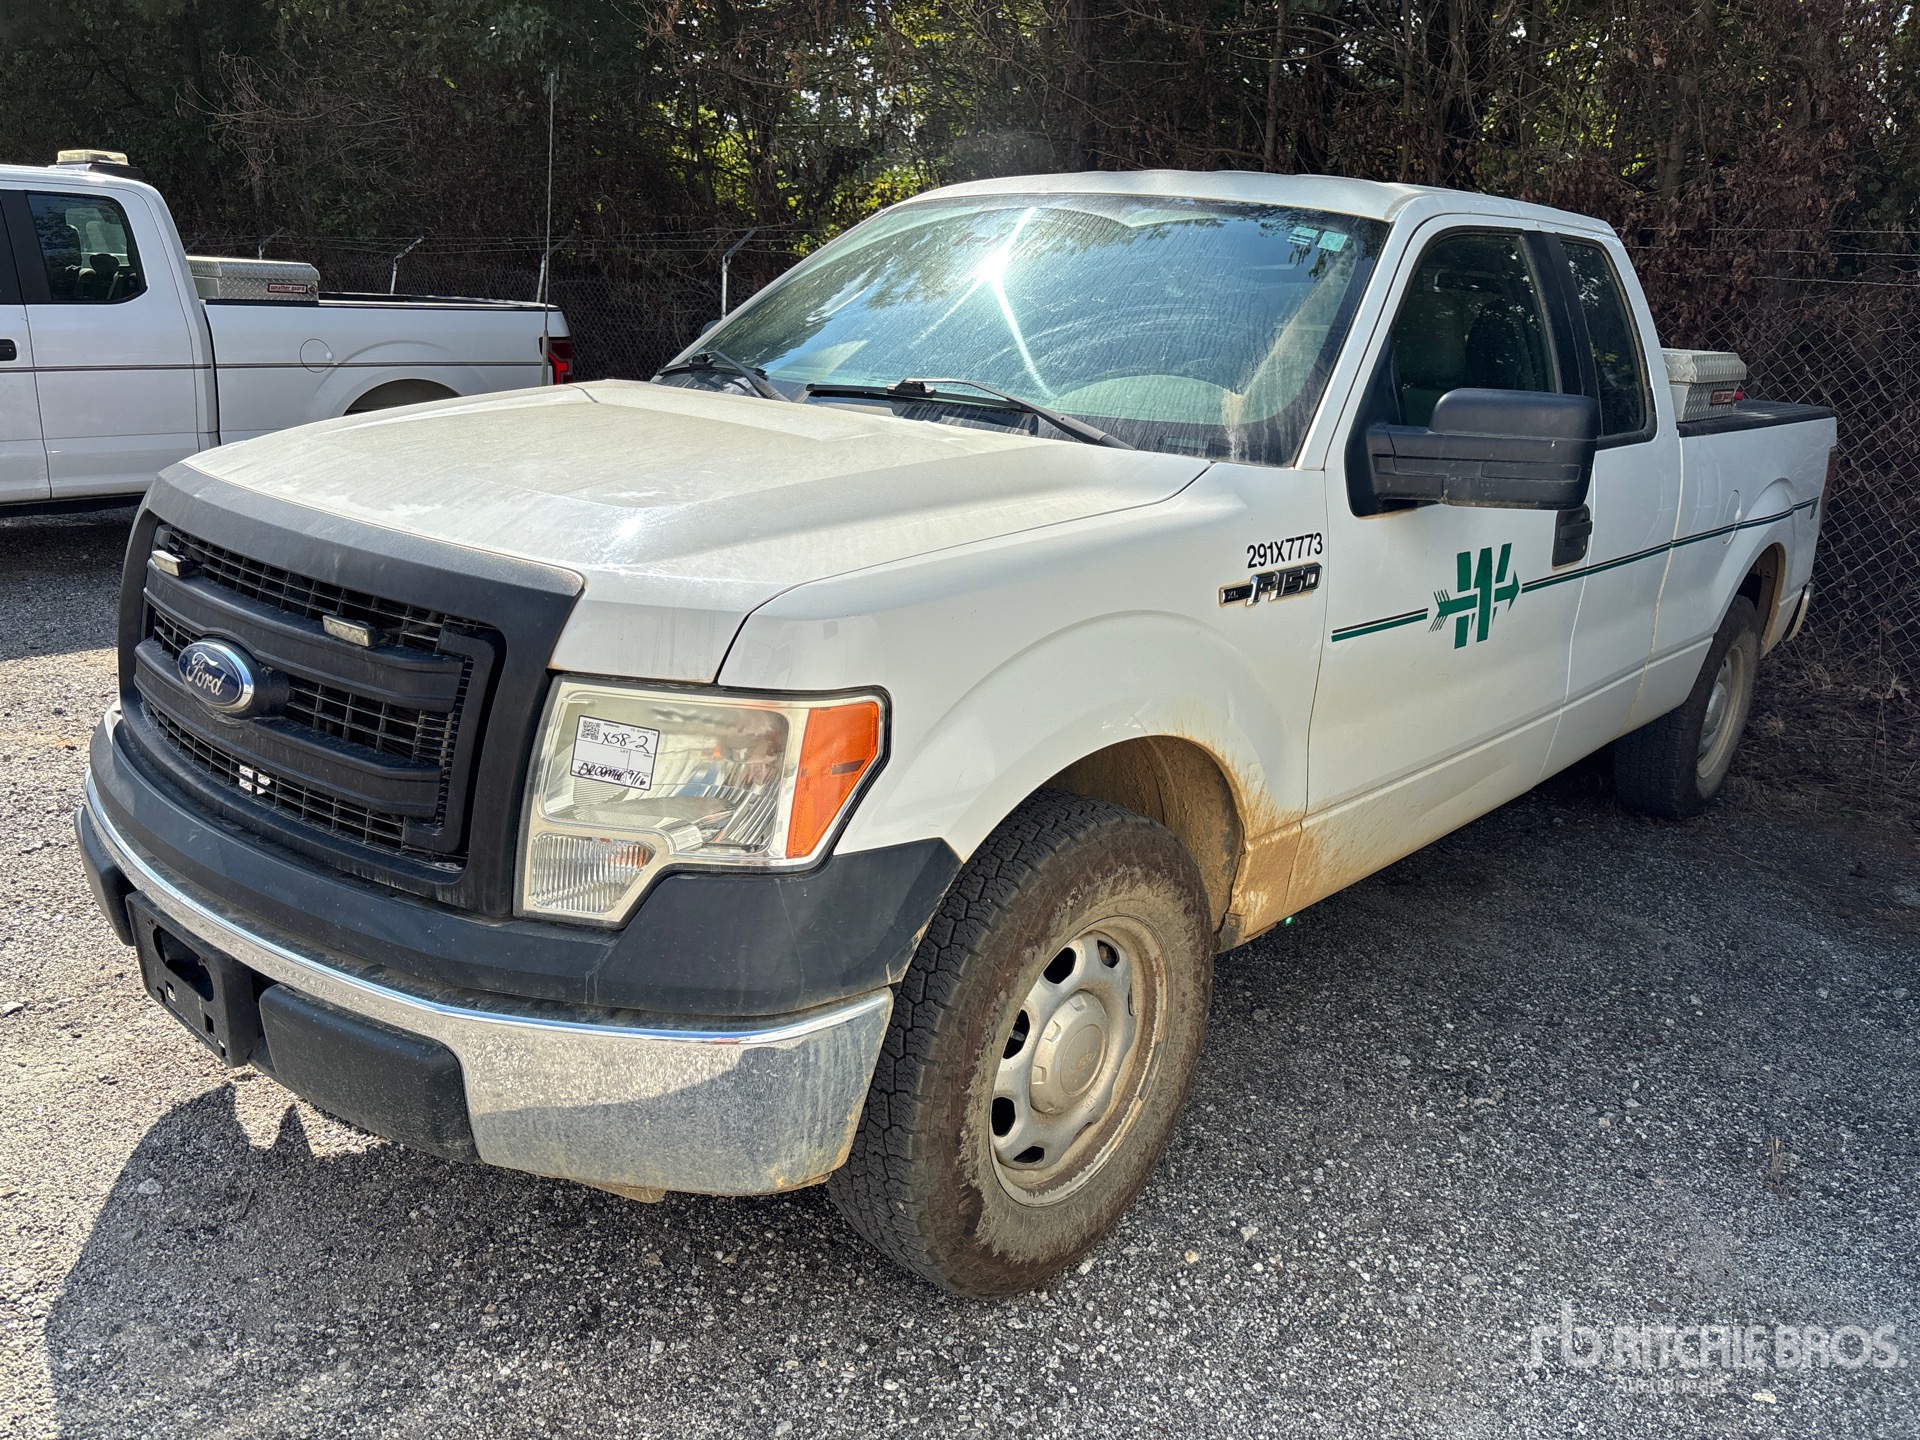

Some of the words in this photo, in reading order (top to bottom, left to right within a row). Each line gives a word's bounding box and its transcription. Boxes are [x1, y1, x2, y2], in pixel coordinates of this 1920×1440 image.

[1246, 532, 1323, 569] 291X7773
[186, 651, 226, 696] Ford
[601, 731, 650, 754] X58-2
